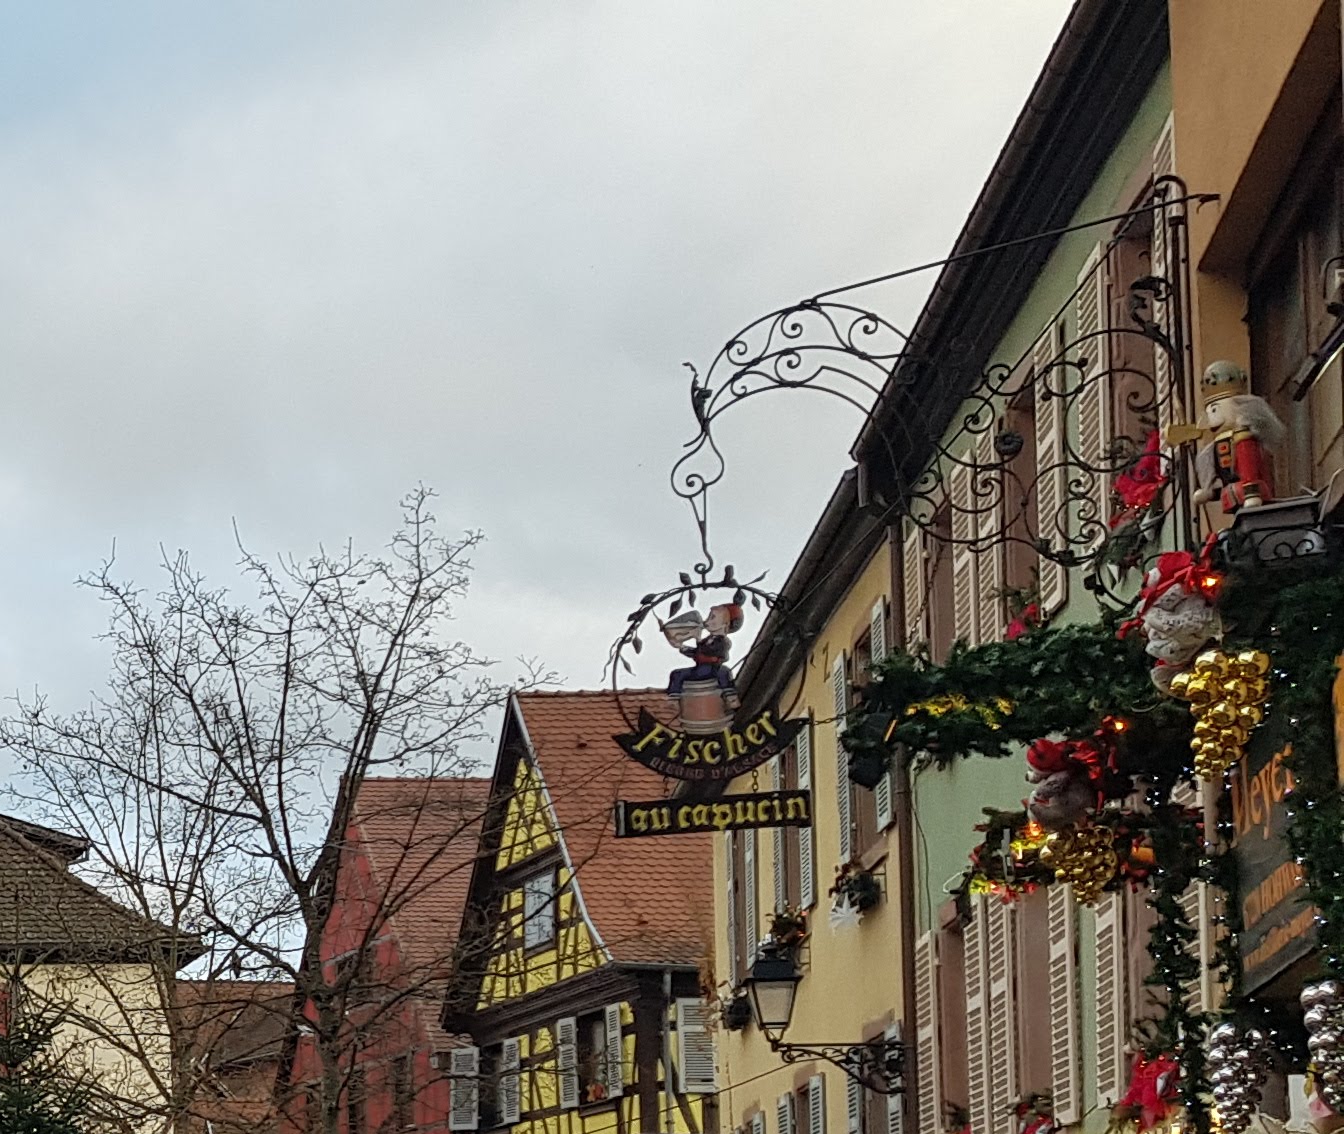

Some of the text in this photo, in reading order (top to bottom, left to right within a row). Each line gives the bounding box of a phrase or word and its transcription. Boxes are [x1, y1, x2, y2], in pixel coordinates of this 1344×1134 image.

[632, 711, 779, 765] Fischer
[631, 793, 808, 832] au capucin
